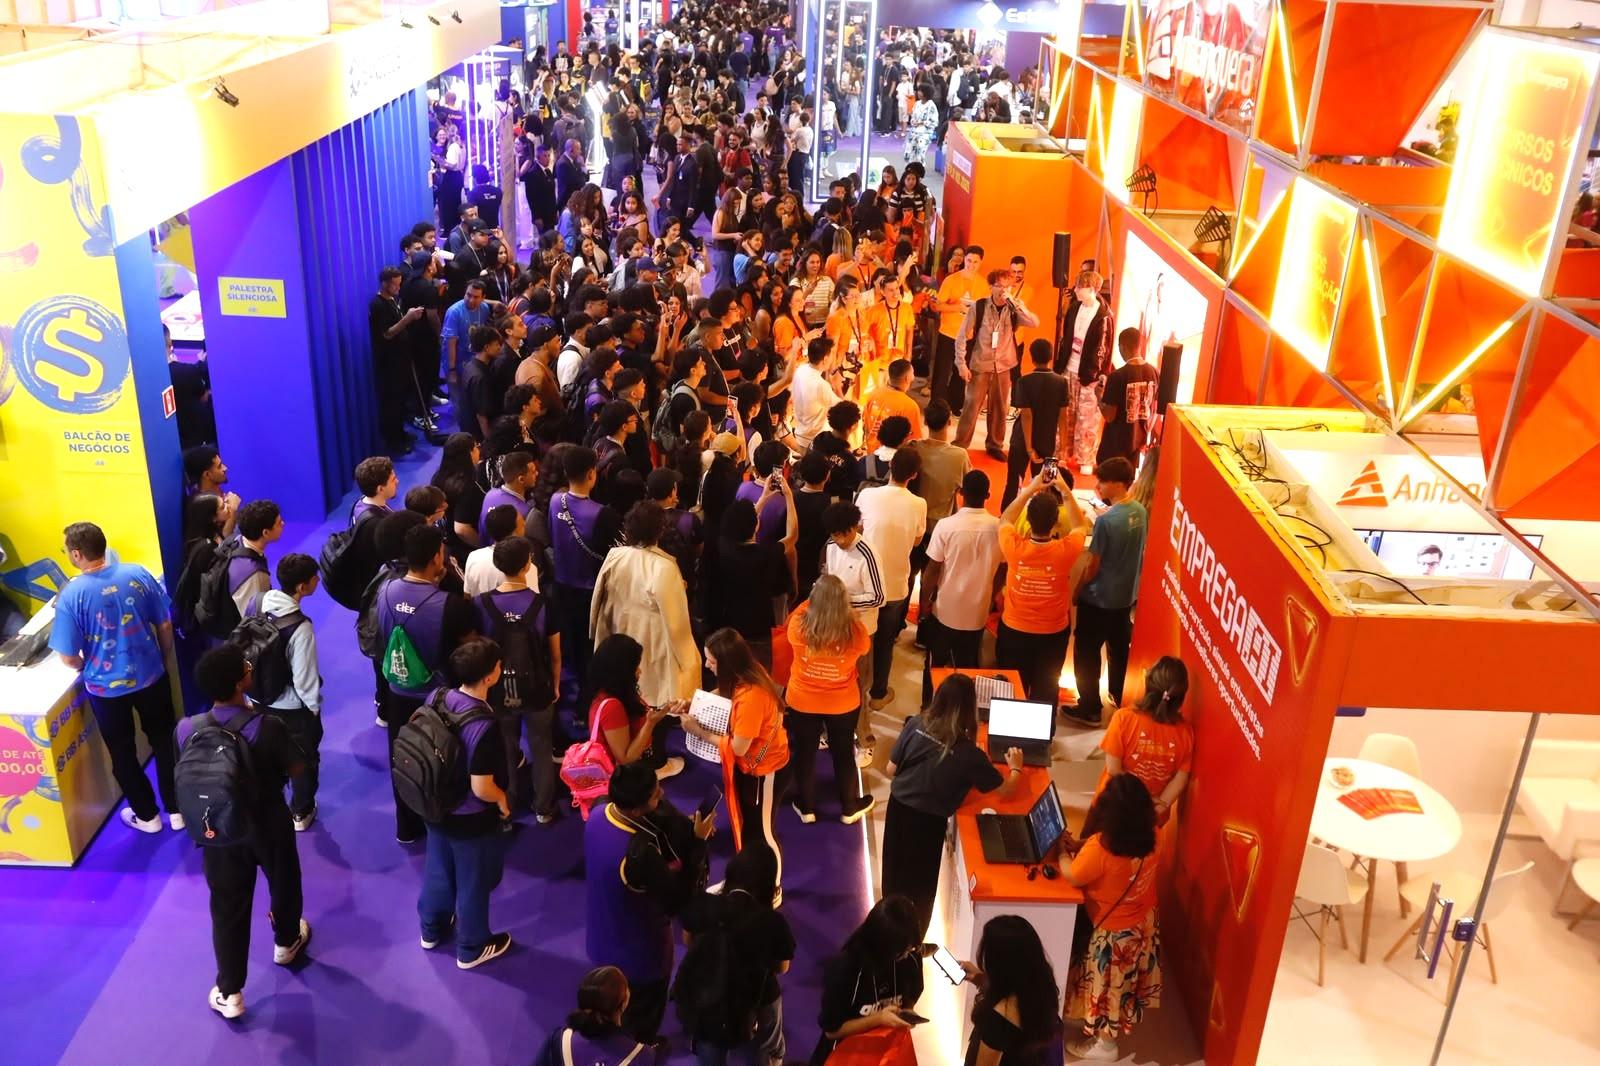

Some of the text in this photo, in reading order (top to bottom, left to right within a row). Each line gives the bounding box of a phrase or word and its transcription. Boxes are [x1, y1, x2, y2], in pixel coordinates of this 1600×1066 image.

[229, 284, 273, 293] PALESTRA
[227, 293, 277, 302] SILENCIOSA
[63, 430, 131, 441] BALCÃO DE
[69, 442, 130, 453] NEGÓCIOS
[1212, 645, 1230, 680] simule
[1230, 676, 1264, 738] entrevistas
[1195, 638, 1218, 684] melhores
[1218, 679, 1261, 762] oportunidades.
[2, 750, 45, 760] DE ATÉ
